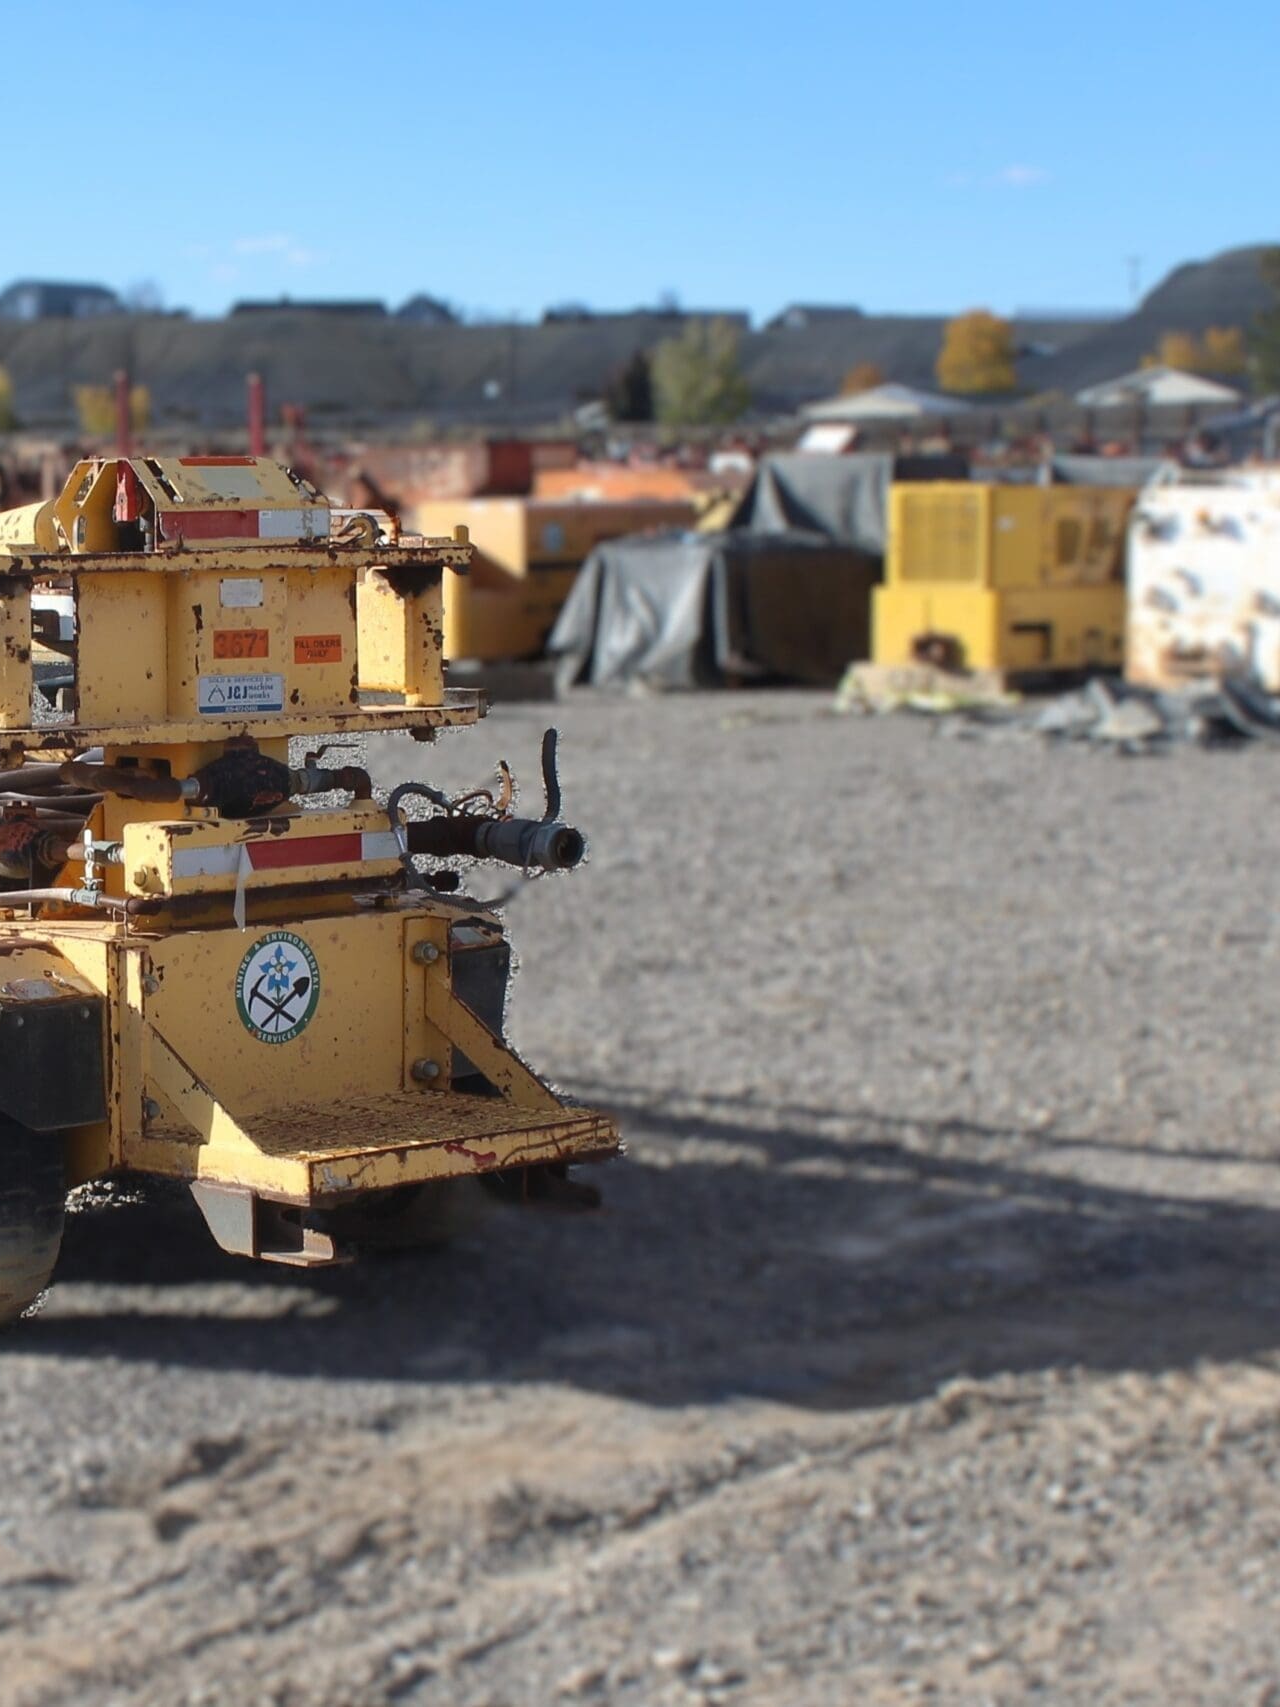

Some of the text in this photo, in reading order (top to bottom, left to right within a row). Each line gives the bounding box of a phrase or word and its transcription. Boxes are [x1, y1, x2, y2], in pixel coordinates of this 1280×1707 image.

[295, 640, 310, 648] FILL
[227, 685, 247, 699] J&J
[236, 955, 251, 998] MINING
[266, 932, 320, 990] ENVIRONMENTAL
[257, 1029, 297, 1042] SERVICES
